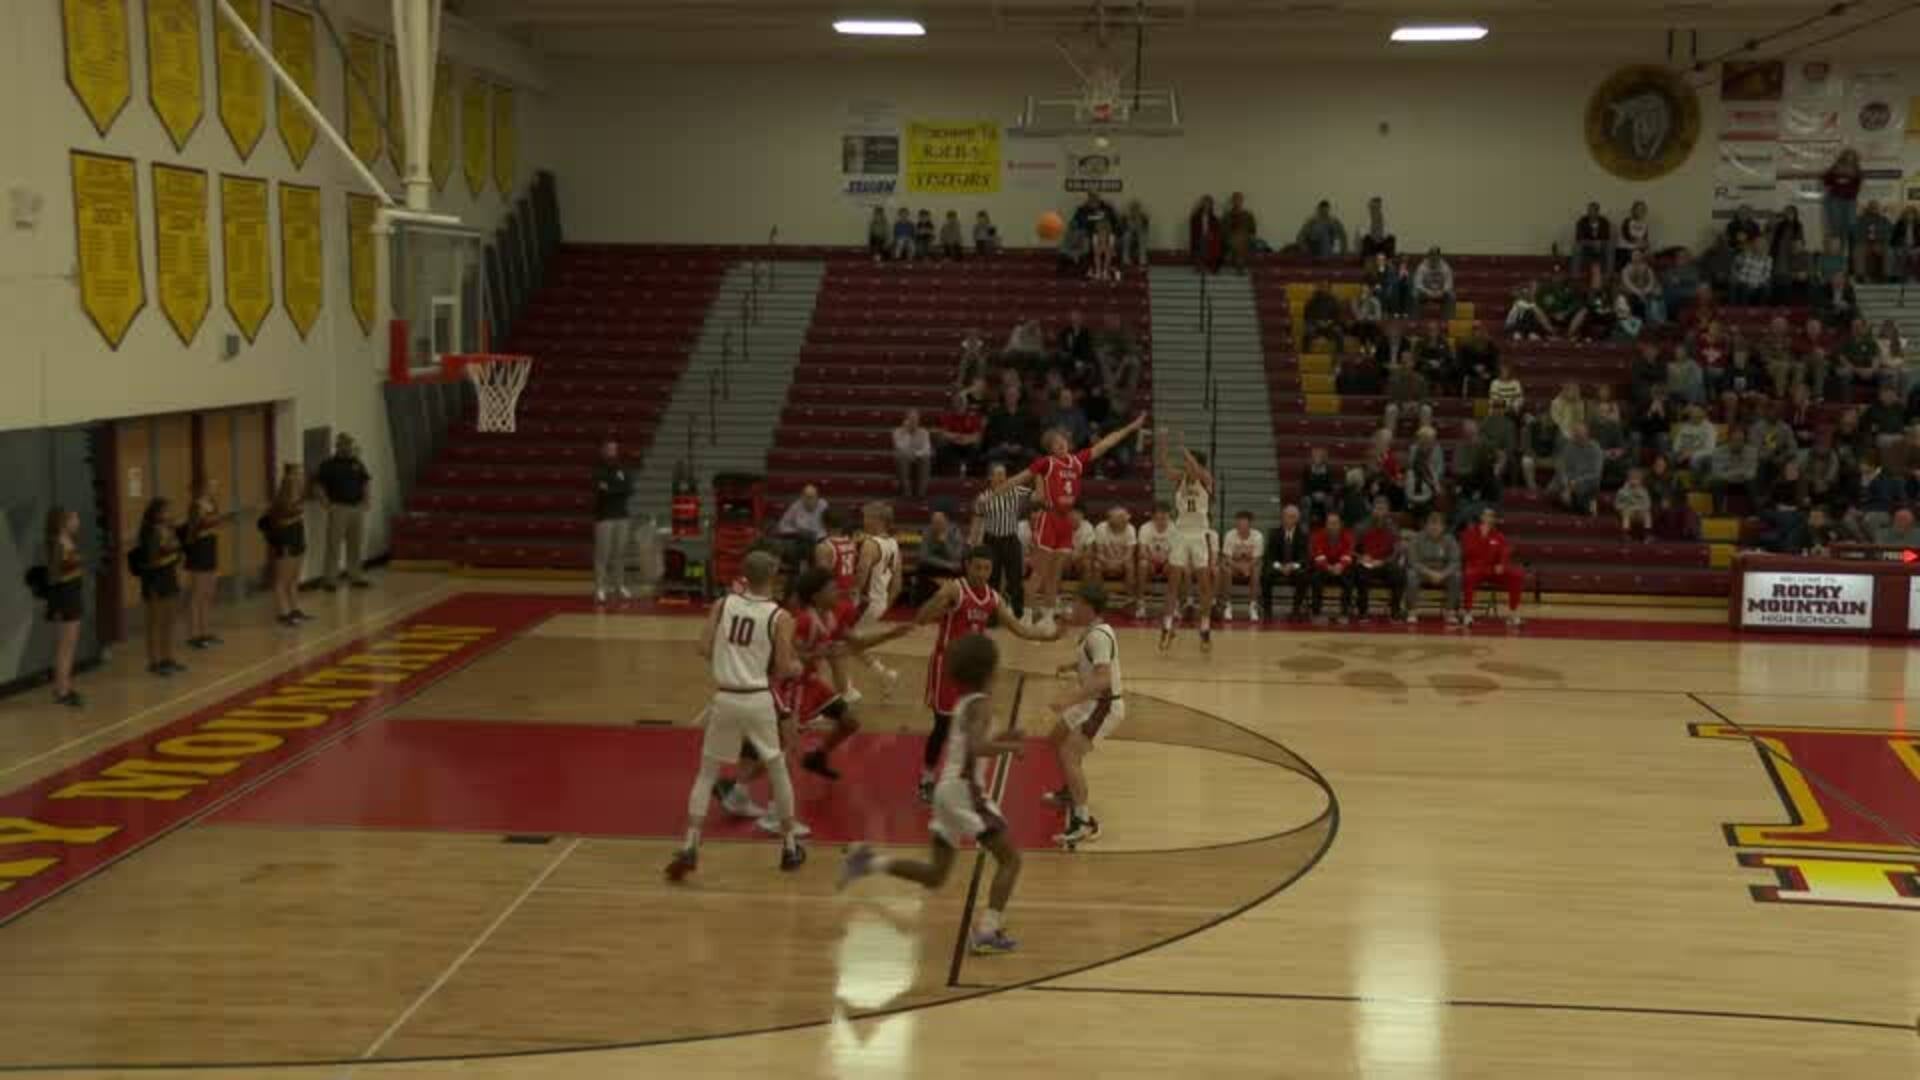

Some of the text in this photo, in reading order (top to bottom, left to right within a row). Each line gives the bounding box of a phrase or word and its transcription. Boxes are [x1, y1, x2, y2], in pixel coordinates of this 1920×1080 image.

[1771, 583, 1844, 599] ROCKY
[1747, 598, 1867, 616] MOUNTAIN
[1760, 614, 1848, 626] HIGH SCHOOL
[729, 615, 756, 647] 10
[47, 624, 497, 801] MOUNTAIN
